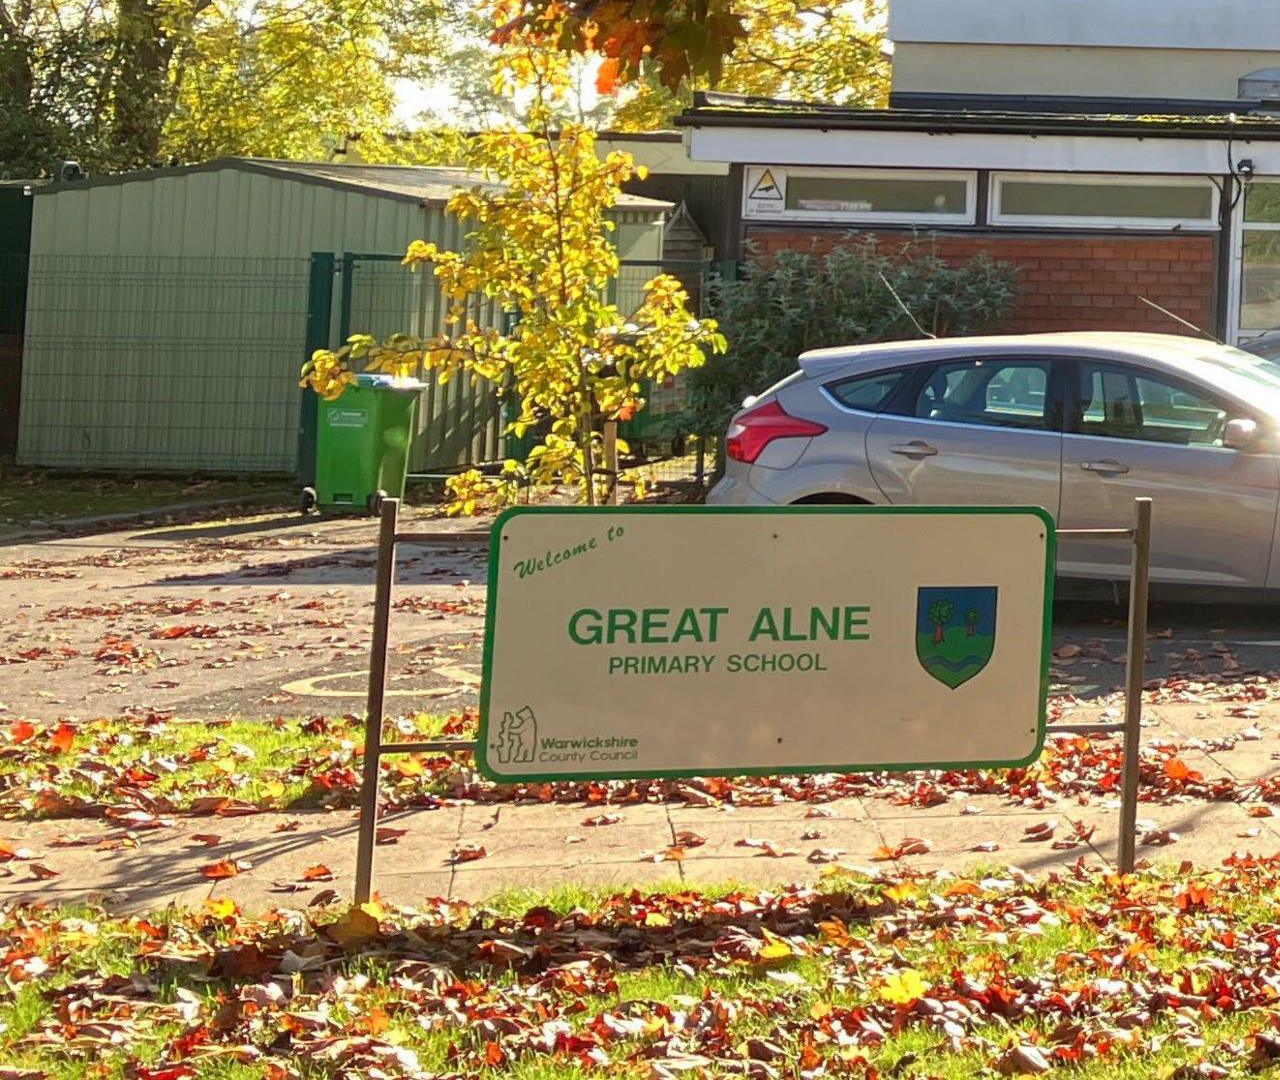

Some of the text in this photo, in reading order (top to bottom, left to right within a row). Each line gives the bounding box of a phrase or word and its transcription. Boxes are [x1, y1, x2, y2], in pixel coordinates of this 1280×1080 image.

[513, 526, 625, 579] Welcome to
[568, 606, 871, 645] GREAT ALNE
[609, 653, 828, 675] PRIMARY SCHOOL
[541, 737, 639, 750] Warwickshire
[539, 750, 638, 763] County Council
